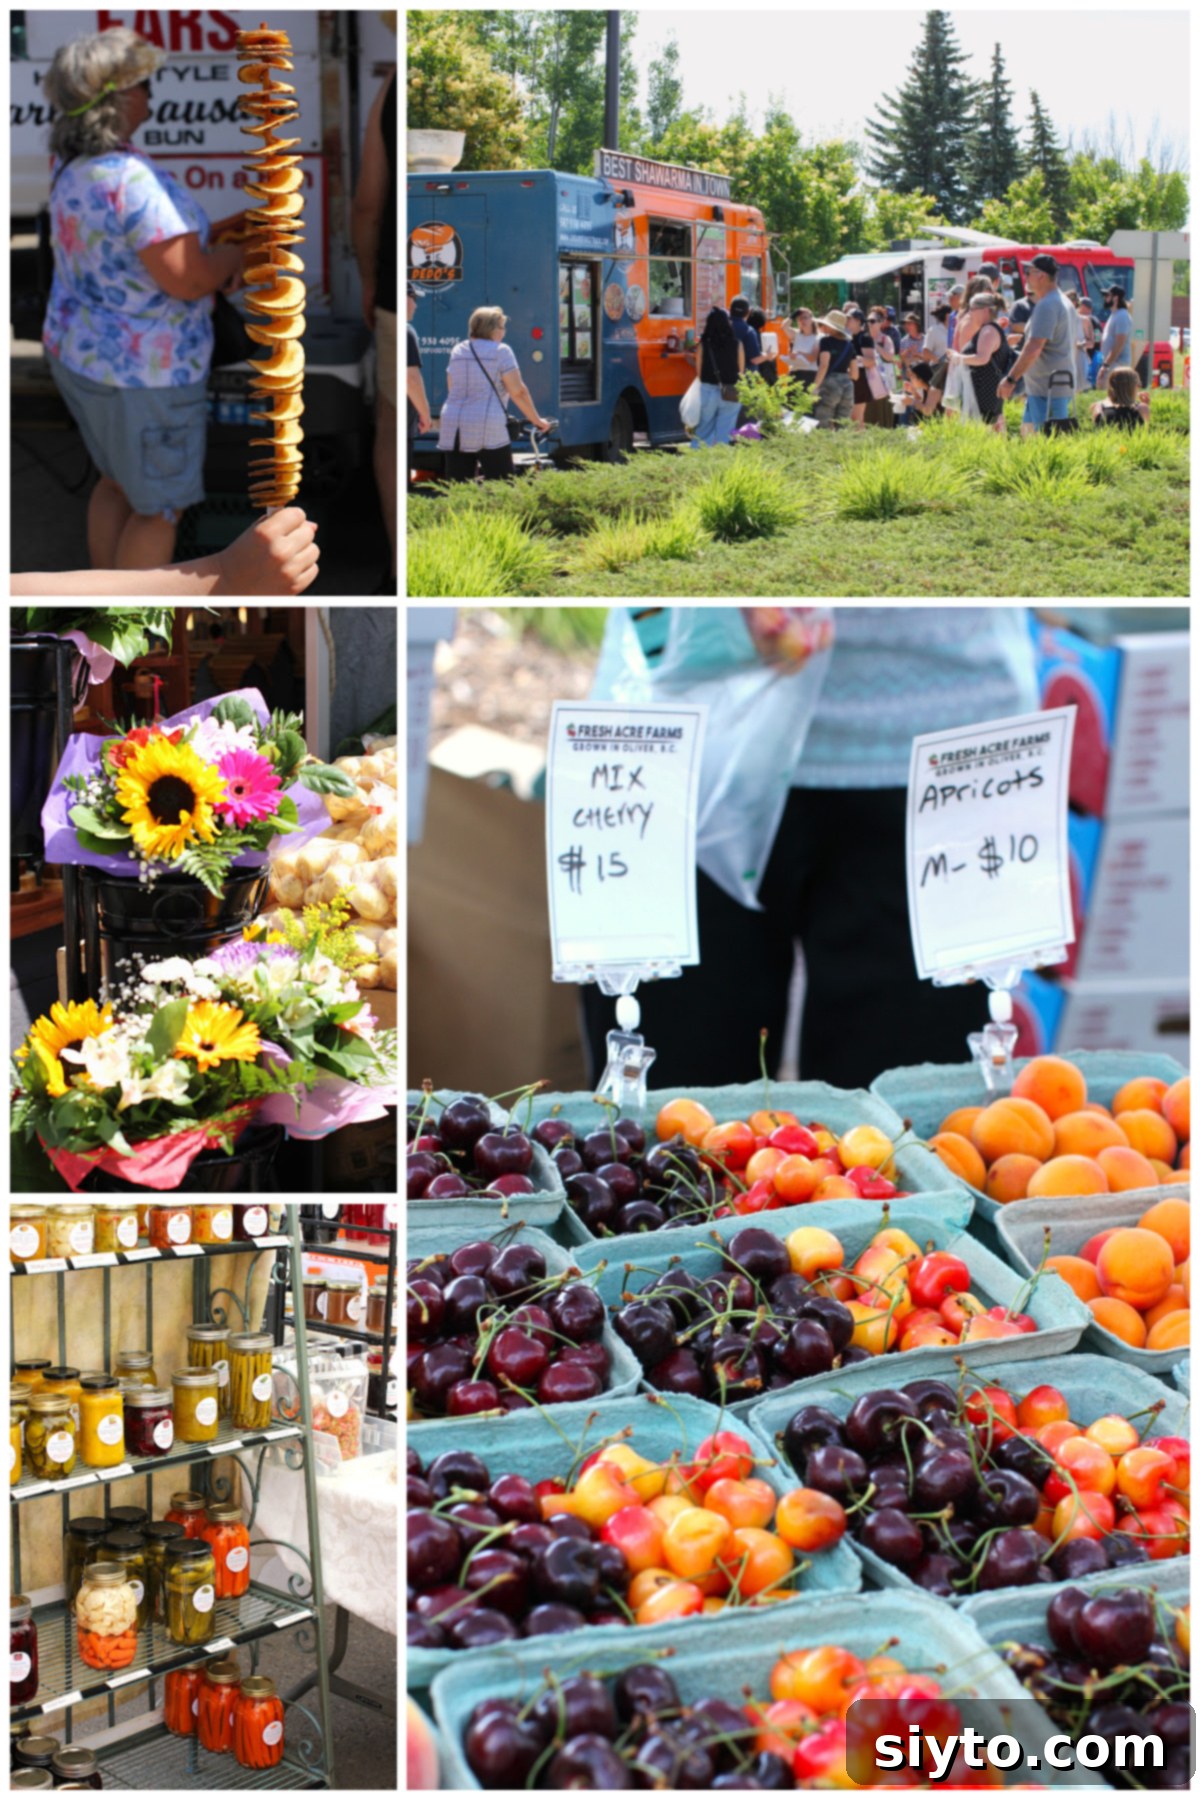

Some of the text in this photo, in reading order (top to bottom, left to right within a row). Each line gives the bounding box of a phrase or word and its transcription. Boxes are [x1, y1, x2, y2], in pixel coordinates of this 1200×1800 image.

[144, 130, 204, 146] BUN
[185, 165, 225, 189] On
[603, 155, 632, 180] BEST
[634, 161, 692, 192] SHAWARMA
[702, 174, 731, 199] TOWN
[578, 724, 684, 740] FRESH ACRE FARMS
[573, 742, 608, 753] GROWN
[609, 743, 620, 753] IN
[940, 732, 1051, 763] FRESH ACRE FARMS
[591, 763, 646, 791] MIX
[935, 763, 972, 777] GROWN
[977, 834, 1038, 878] $10
